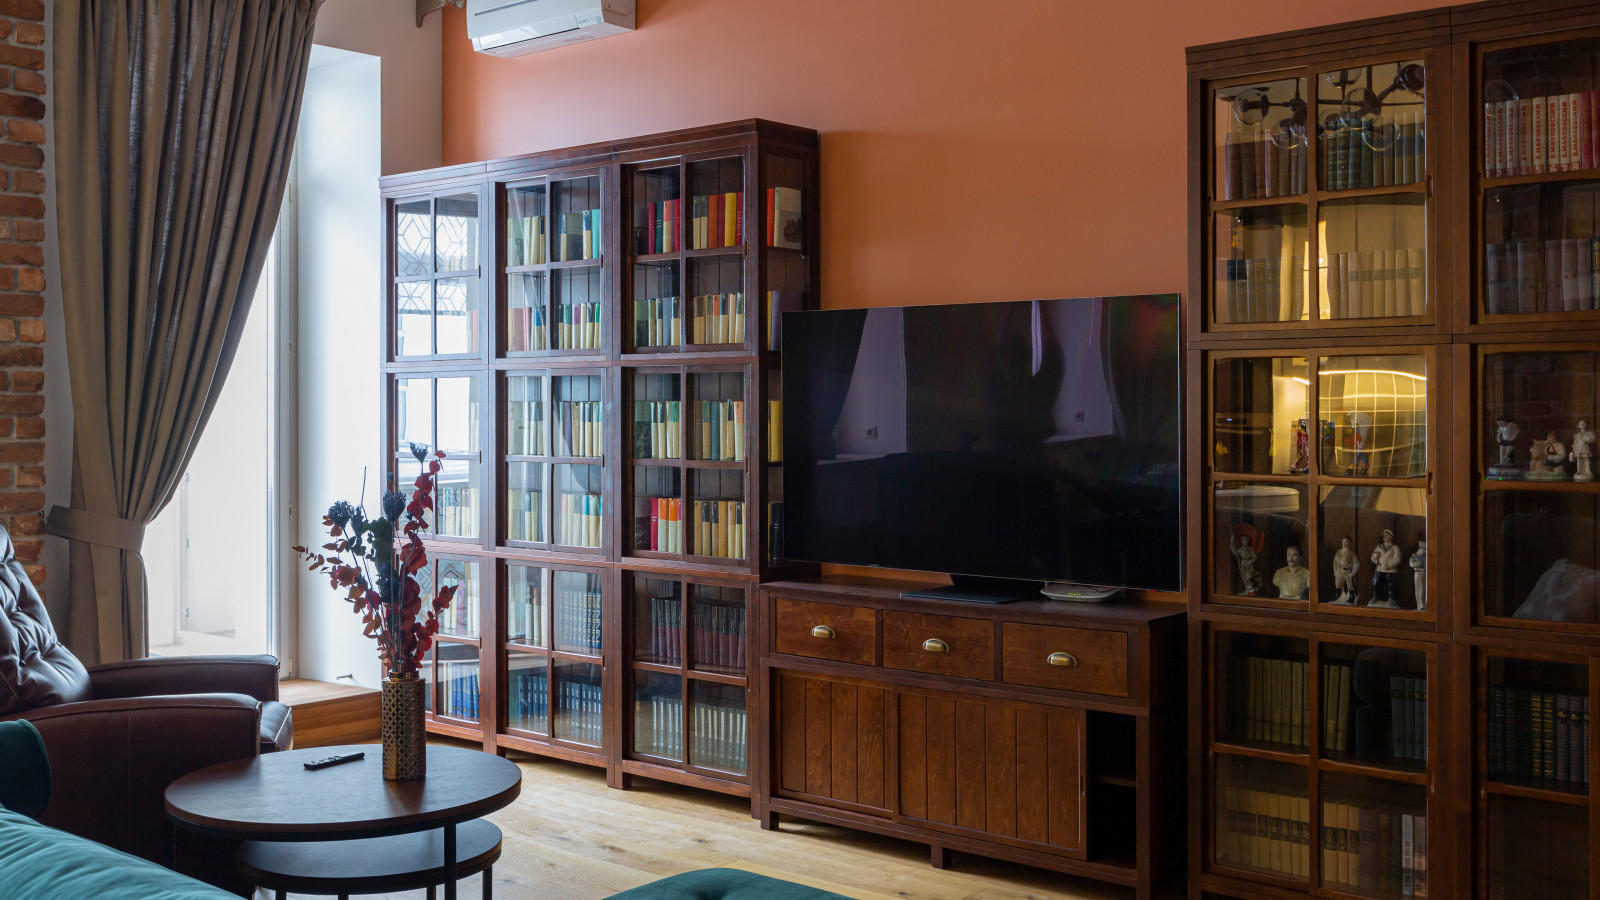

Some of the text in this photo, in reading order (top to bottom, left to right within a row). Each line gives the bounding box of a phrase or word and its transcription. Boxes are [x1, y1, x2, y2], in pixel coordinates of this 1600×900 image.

[1535, 166, 1541, 174] 5
[1549, 164, 1557, 173] 6
[1561, 164, 1568, 172] 7
[1572, 163, 1579, 171] 8
